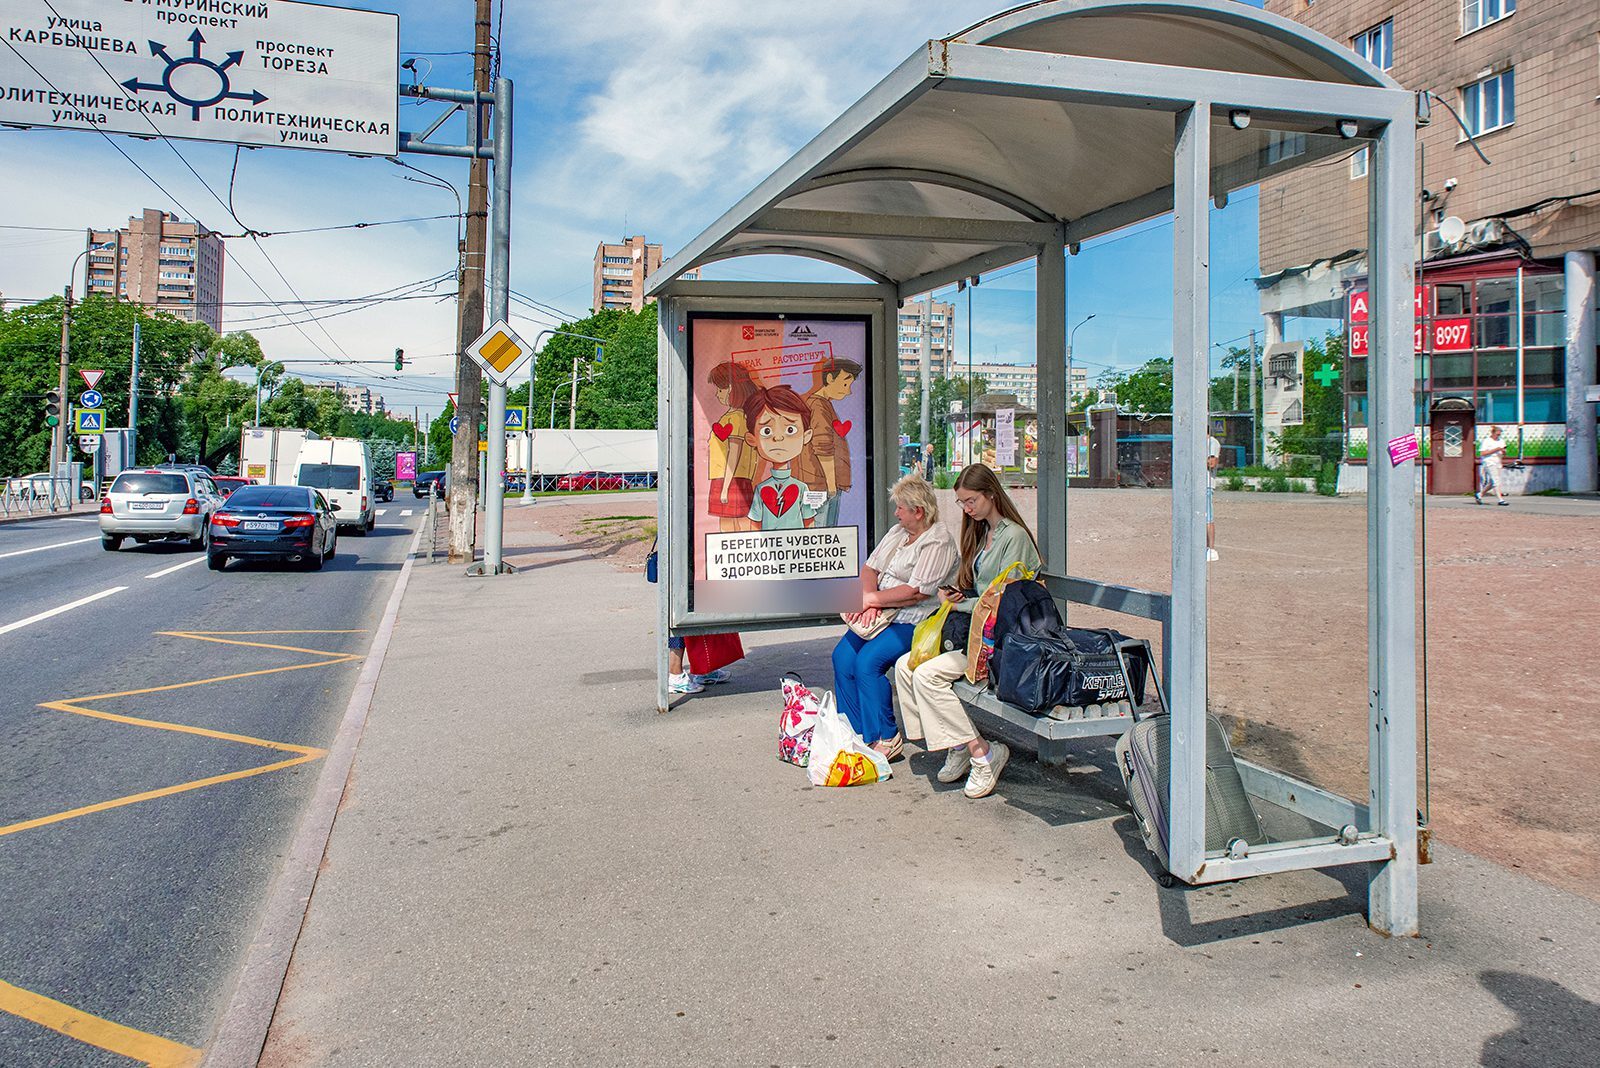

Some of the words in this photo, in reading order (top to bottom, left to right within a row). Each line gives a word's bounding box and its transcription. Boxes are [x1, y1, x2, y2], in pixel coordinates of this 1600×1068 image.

[47, 16, 103, 32] улица
[157, 10, 238, 29] проспект
[9, 27, 138, 54] КАРБЫШЕВА
[256, 40, 335, 58] проспект
[261, 56, 329, 75] ТОРЕЗА
[52, 109, 107, 124] улица
[215, 107, 390, 135] ПОЛИТЕХНИЧЕСКАЯ
[280, 129, 329, 144] улица
[1436, 325, 1468, 346] 8997
[772, 350, 825, 365] РАСТОРГНУТ
[721, 537, 783, 551] БЕРЕГИТЕ
[786, 534, 840, 547] ЧУВСТВА
[715, 554, 723, 565] И
[727, 546, 847, 564] ПСИХОЛОГИЧЕСКОЕ
[720, 563, 786, 579] ЗДОРОВЬЕ
[789, 560, 845, 574] РЕБЕНКА
[1082, 674, 1125, 690] KETTLE
